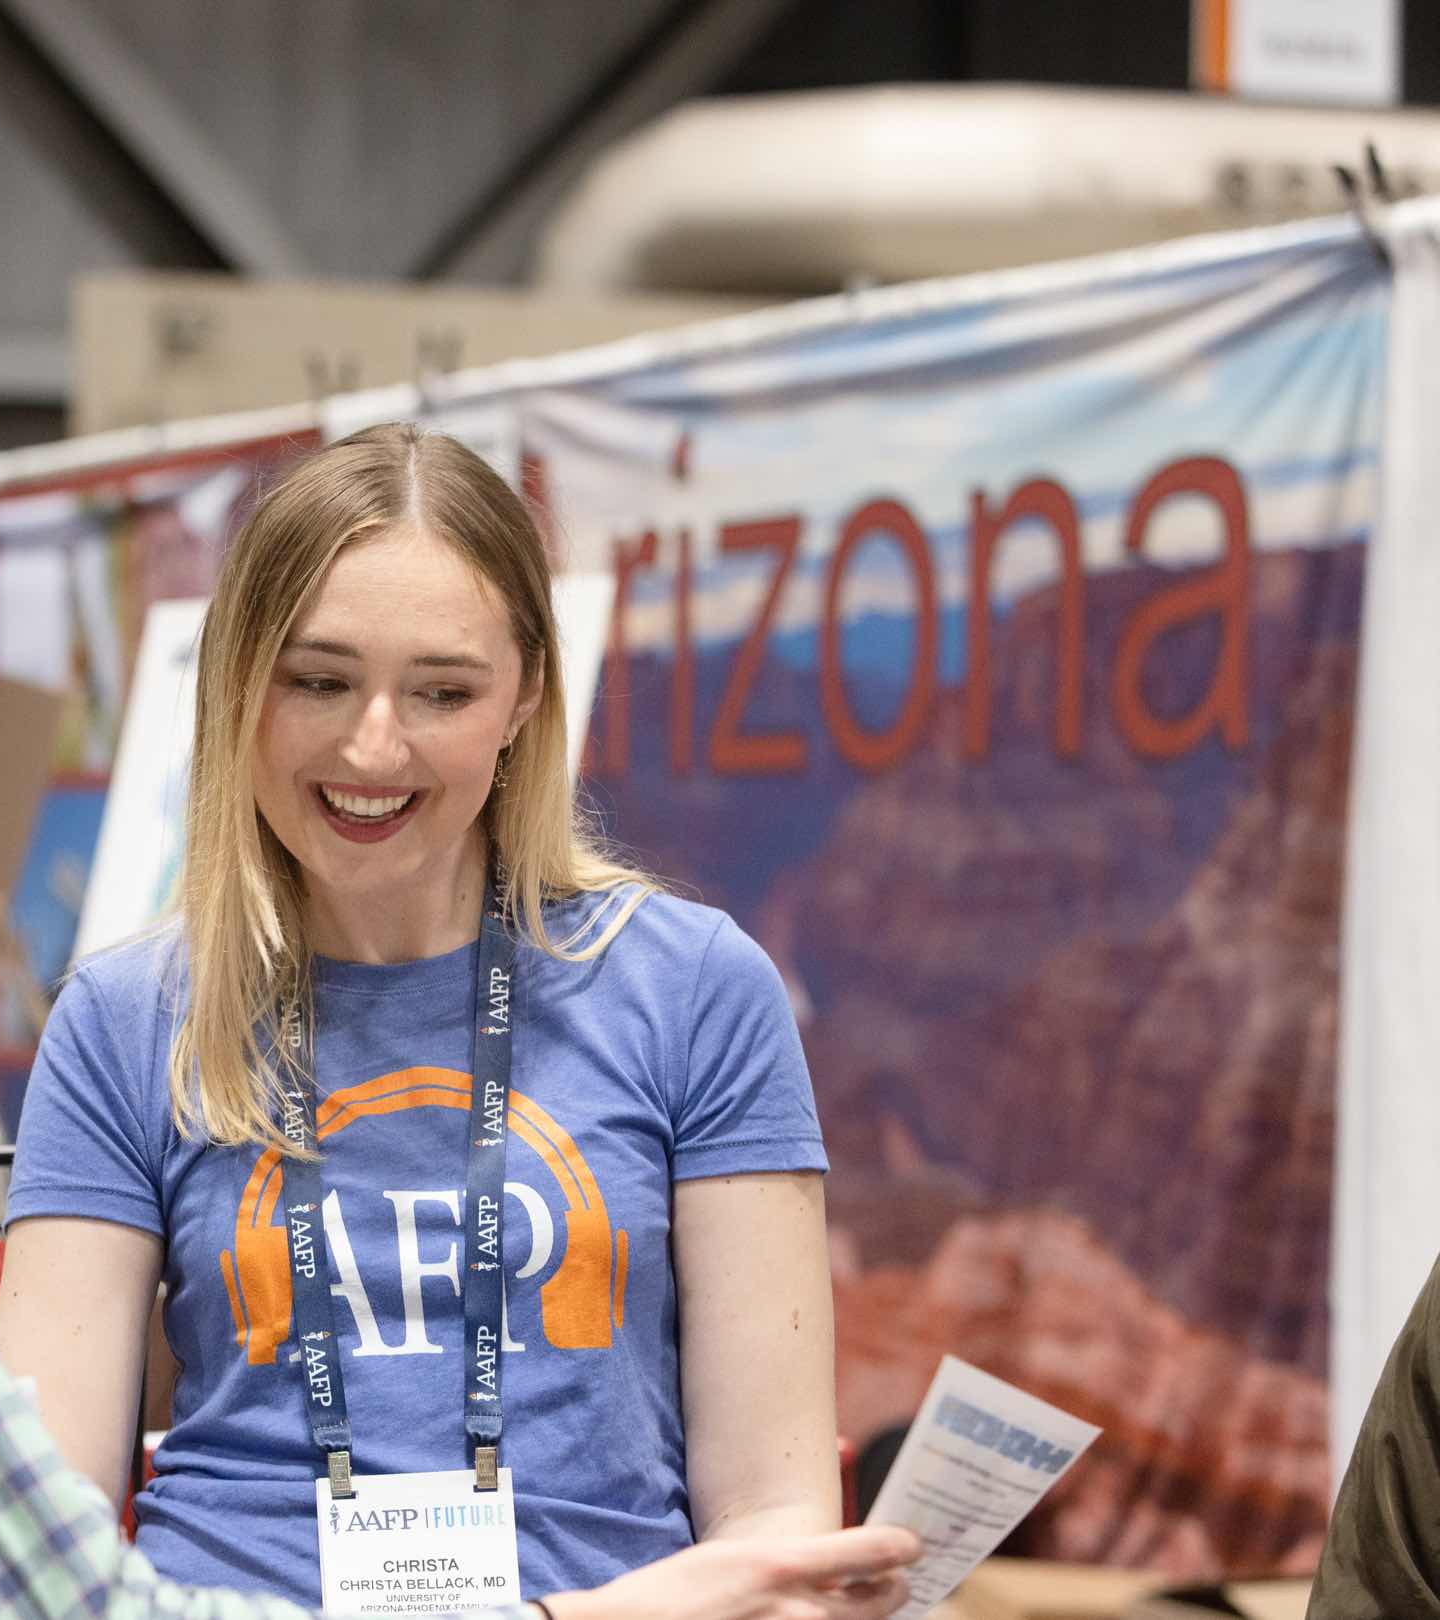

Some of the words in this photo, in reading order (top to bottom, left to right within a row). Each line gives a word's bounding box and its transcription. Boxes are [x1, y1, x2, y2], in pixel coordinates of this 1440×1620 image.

[522, 434, 1253, 778] rizona
[488, 967, 509, 1024] AAFP
[483, 1080, 504, 1135] AAFP
[291, 1217, 316, 1279] AAFP
[478, 1195, 499, 1258] AAFP
[305, 1345, 333, 1407] AAFP
[476, 1325, 497, 1390] AAFP
[345, 1508, 418, 1532] AAFP
[434, 1503, 506, 1529] FUTURE
[339, 1579, 402, 1591] CHRISTA
[406, 1577, 479, 1590] BELLACK,
[483, 1576, 506, 1588] MD
[382, 1558, 460, 1574] CHRISTA
[385, 1593, 445, 1603] UNIVERSITY
[447, 1593, 462, 1602] OF
